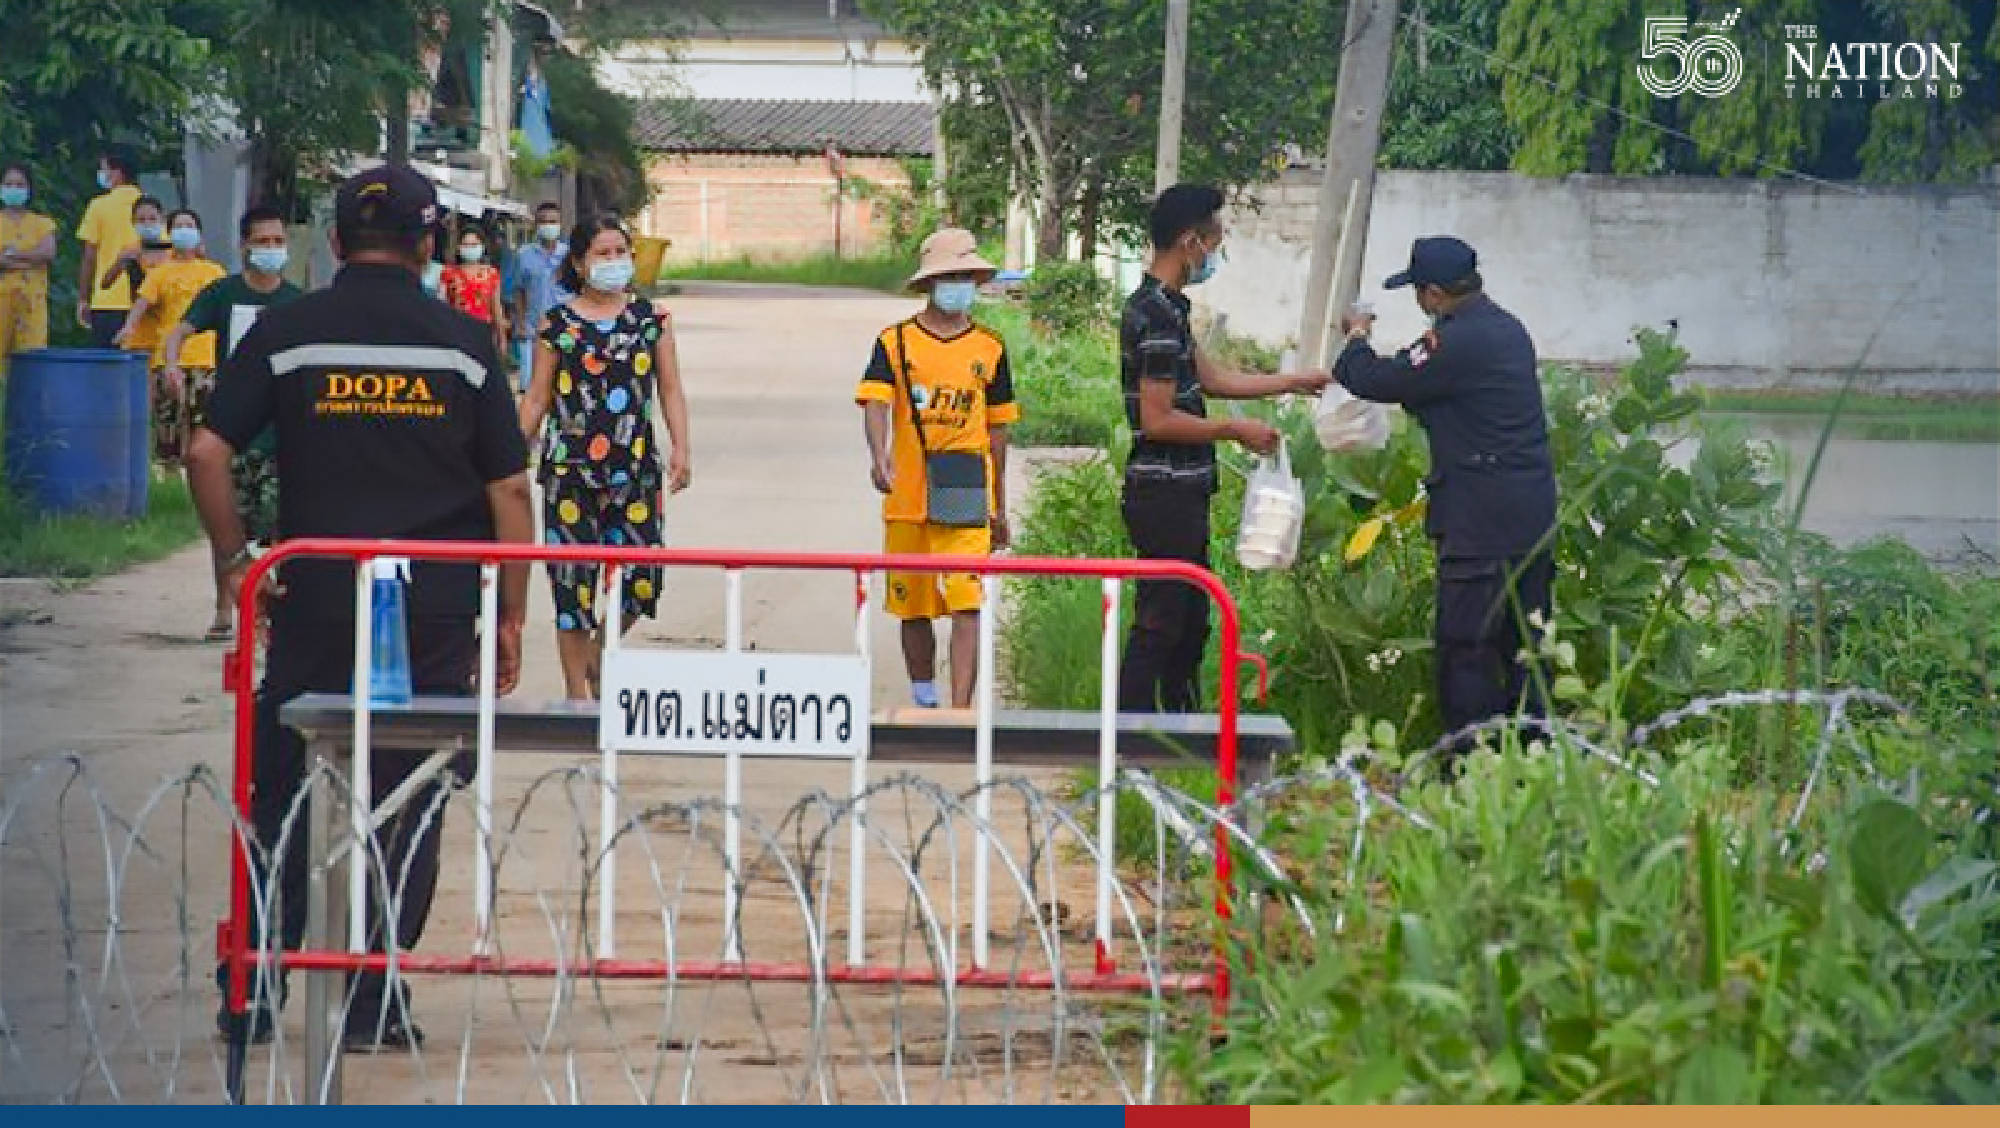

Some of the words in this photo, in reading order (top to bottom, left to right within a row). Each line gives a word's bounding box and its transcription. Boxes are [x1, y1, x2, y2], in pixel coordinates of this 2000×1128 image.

[326, 374, 432, 400] DOPA
[618, 668, 853, 743] ทต.แม่ตาว
